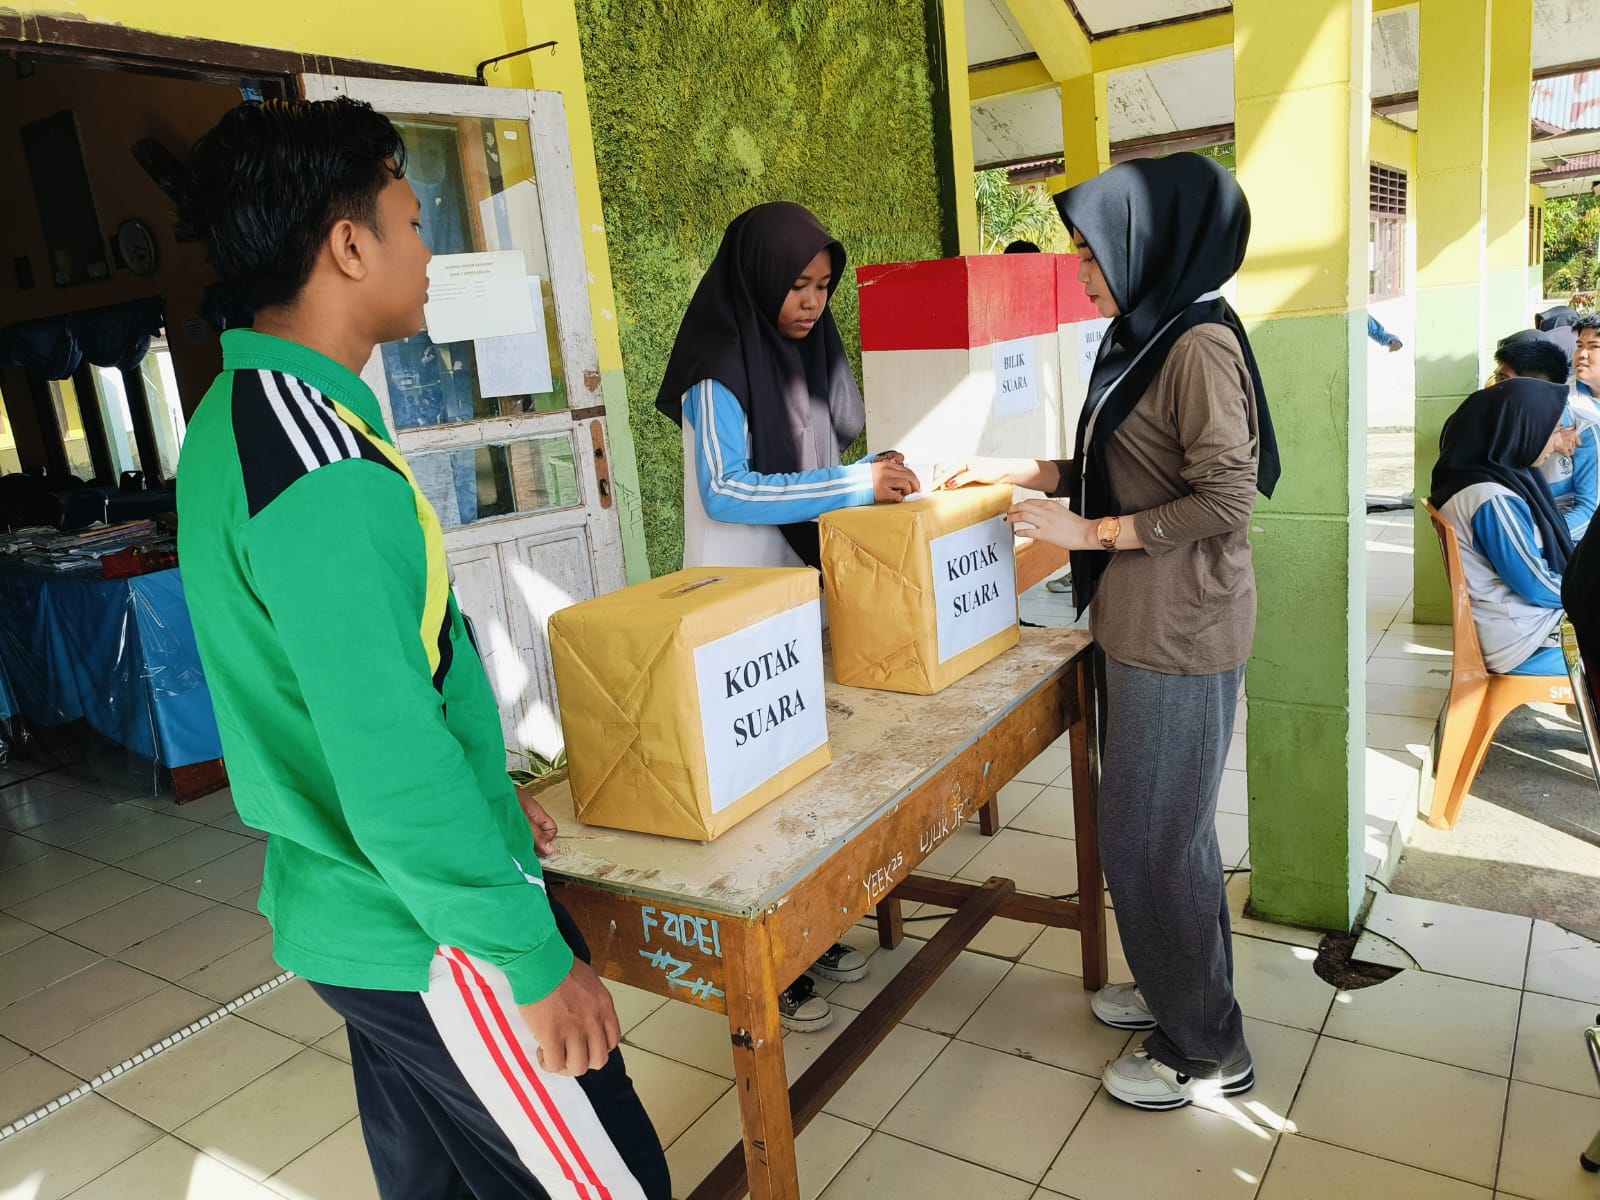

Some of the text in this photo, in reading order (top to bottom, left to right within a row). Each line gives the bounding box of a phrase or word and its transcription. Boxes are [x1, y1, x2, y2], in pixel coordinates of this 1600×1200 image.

[1003, 352, 1025, 370] BILIK
[1002, 376, 1028, 394] SUARA
[947, 542, 999, 581] KOTAK
[952, 580, 1000, 618] SUARA
[724, 639, 800, 699] KOTAK
[733, 689, 806, 748] SUARA
